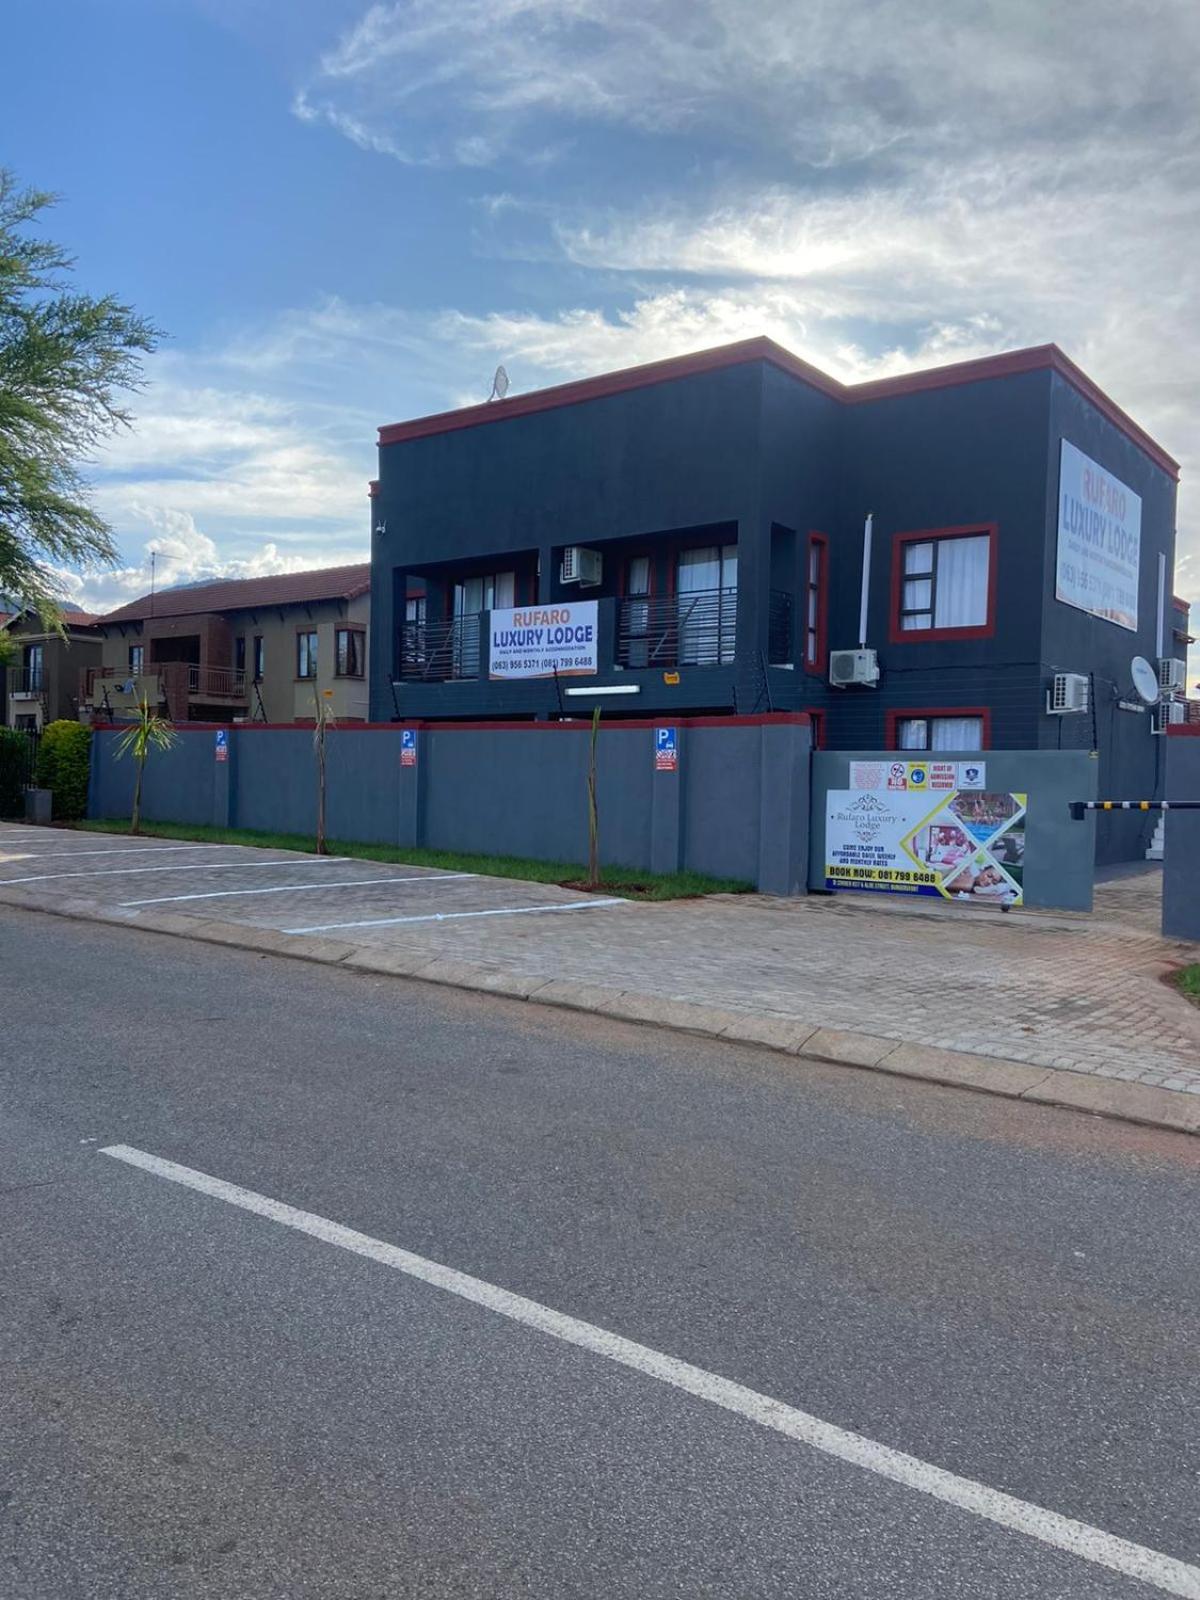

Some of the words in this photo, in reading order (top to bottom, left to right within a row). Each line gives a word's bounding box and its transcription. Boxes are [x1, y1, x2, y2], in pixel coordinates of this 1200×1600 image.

[1062, 494, 1106, 548] LUXURY
[1107, 522, 1138, 568] LODGE
[513, 608, 570, 627] RUFARO
[494, 629, 543, 648] LUXURY
[547, 625, 592, 644] LODGE
[510, 660, 522, 669] 956
[524, 660, 540, 669] 5371
[560, 658, 573, 667] 799
[574, 656, 592, 666] 6488
[659, 729, 669, 744] P
[836, 812, 865, 821] Rufaro
[867, 814, 897, 824] Luxury
[855, 821, 880, 829] Lodge
[830, 866, 851, 876] BOOK
[853, 868, 875, 878] NOW:
[878, 870, 892, 879] 081
[895, 871, 911, 881] 799
[913, 872, 936, 883] 6488
